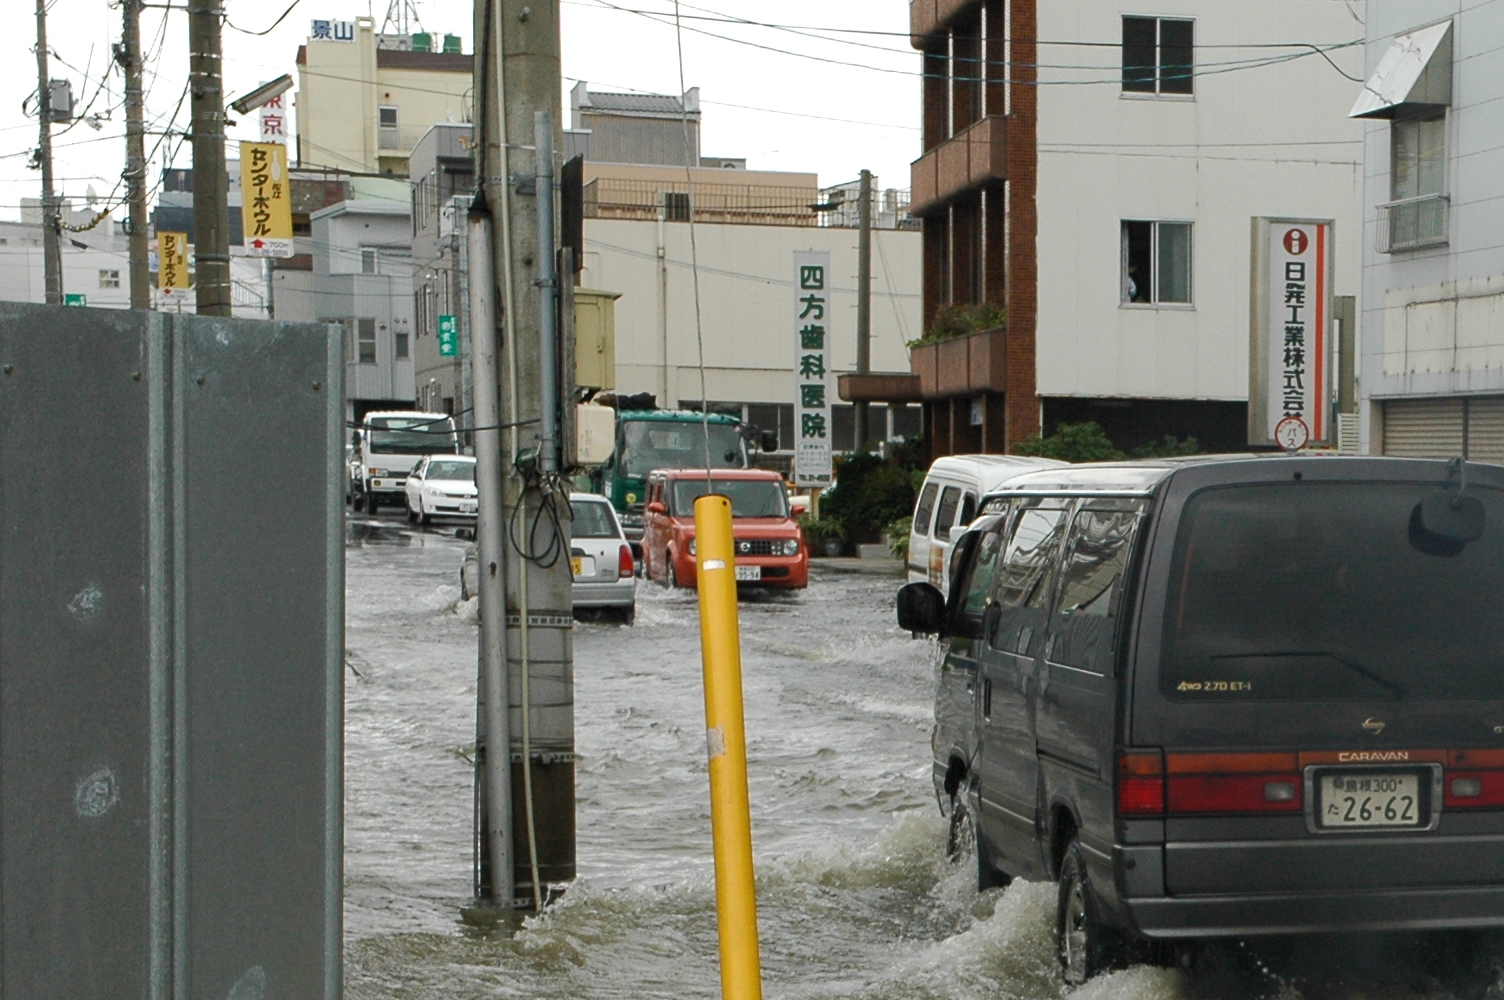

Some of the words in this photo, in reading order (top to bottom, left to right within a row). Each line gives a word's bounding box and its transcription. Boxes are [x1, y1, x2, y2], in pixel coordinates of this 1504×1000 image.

[312, 20, 353, 40] 景山
[799, 266, 826, 438] 四方歯科医院
[1283, 262, 1305, 417] 日発工業株式会
[1339, 751, 1408, 761] CARAVAN
[1343, 796, 1413, 822] 26-62
